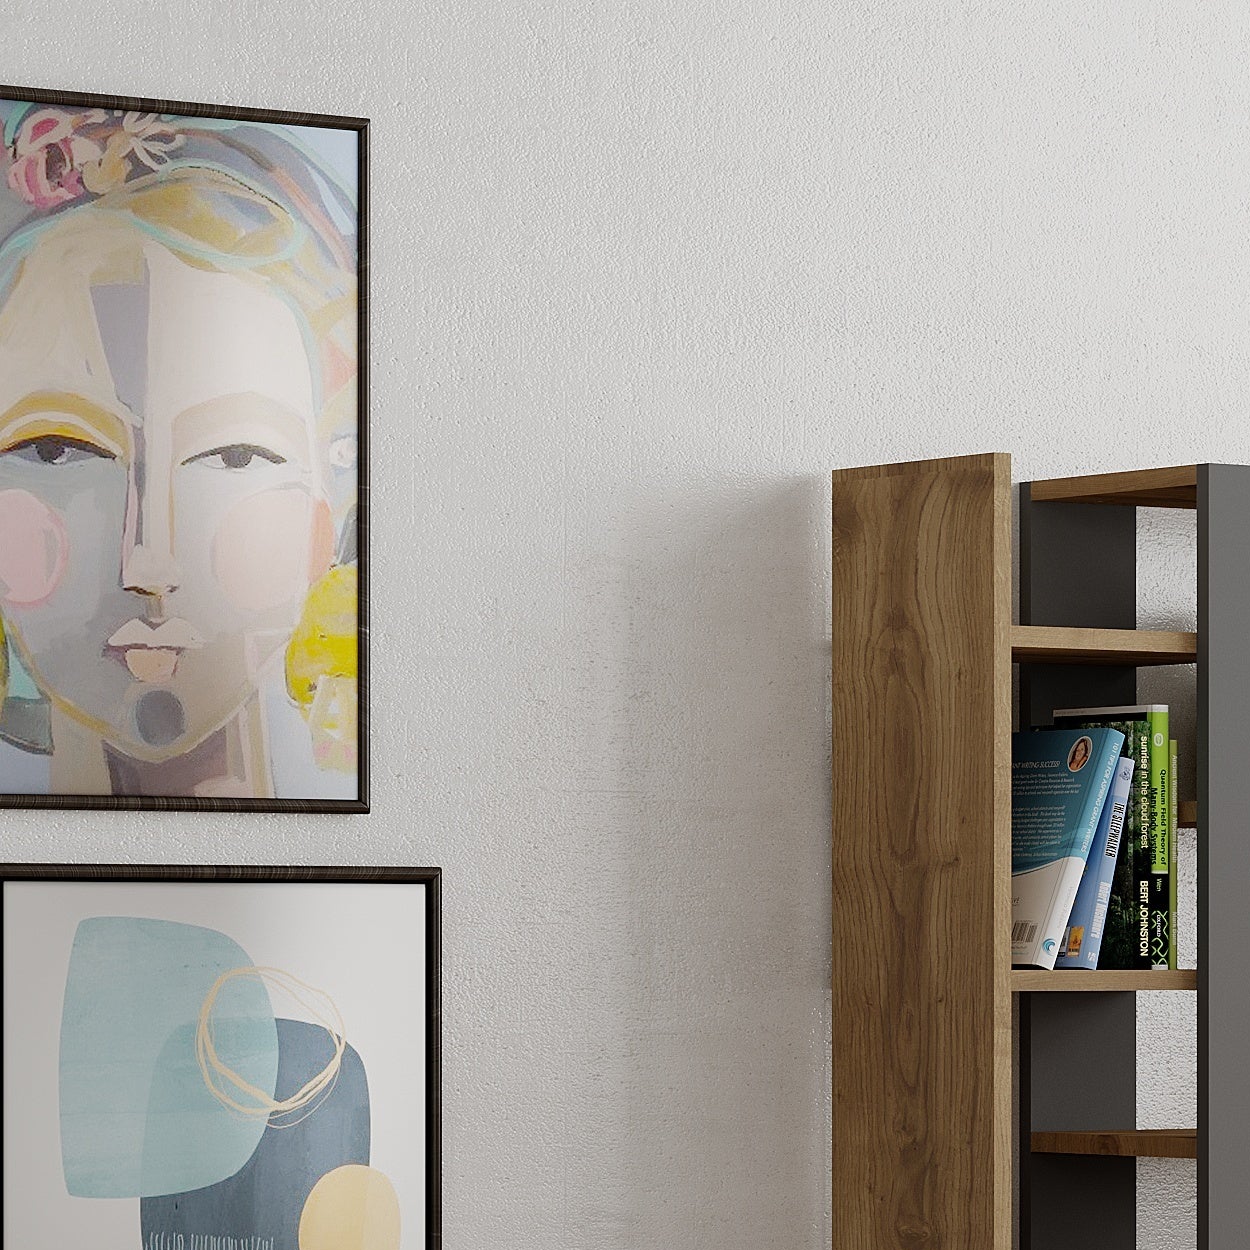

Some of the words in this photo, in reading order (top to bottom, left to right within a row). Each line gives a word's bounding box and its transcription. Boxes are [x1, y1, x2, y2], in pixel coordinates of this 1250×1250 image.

[1140, 736, 1148, 769] sunrise
[1093, 780, 1108, 807] ASPIRING
[1088, 806, 1099, 828] GRANT
[1114, 803, 1125, 814] THE
[1141, 797, 1149, 821] cloud
[1080, 827, 1093, 853] WRITERS
[1105, 815, 1123, 858] SLEEPWALKER
[1141, 823, 1149, 848] forest
[1160, 857, 1166, 865] of
[1140, 881, 1148, 903] BERT
[1140, 905, 1148, 956] JOHNSTON
